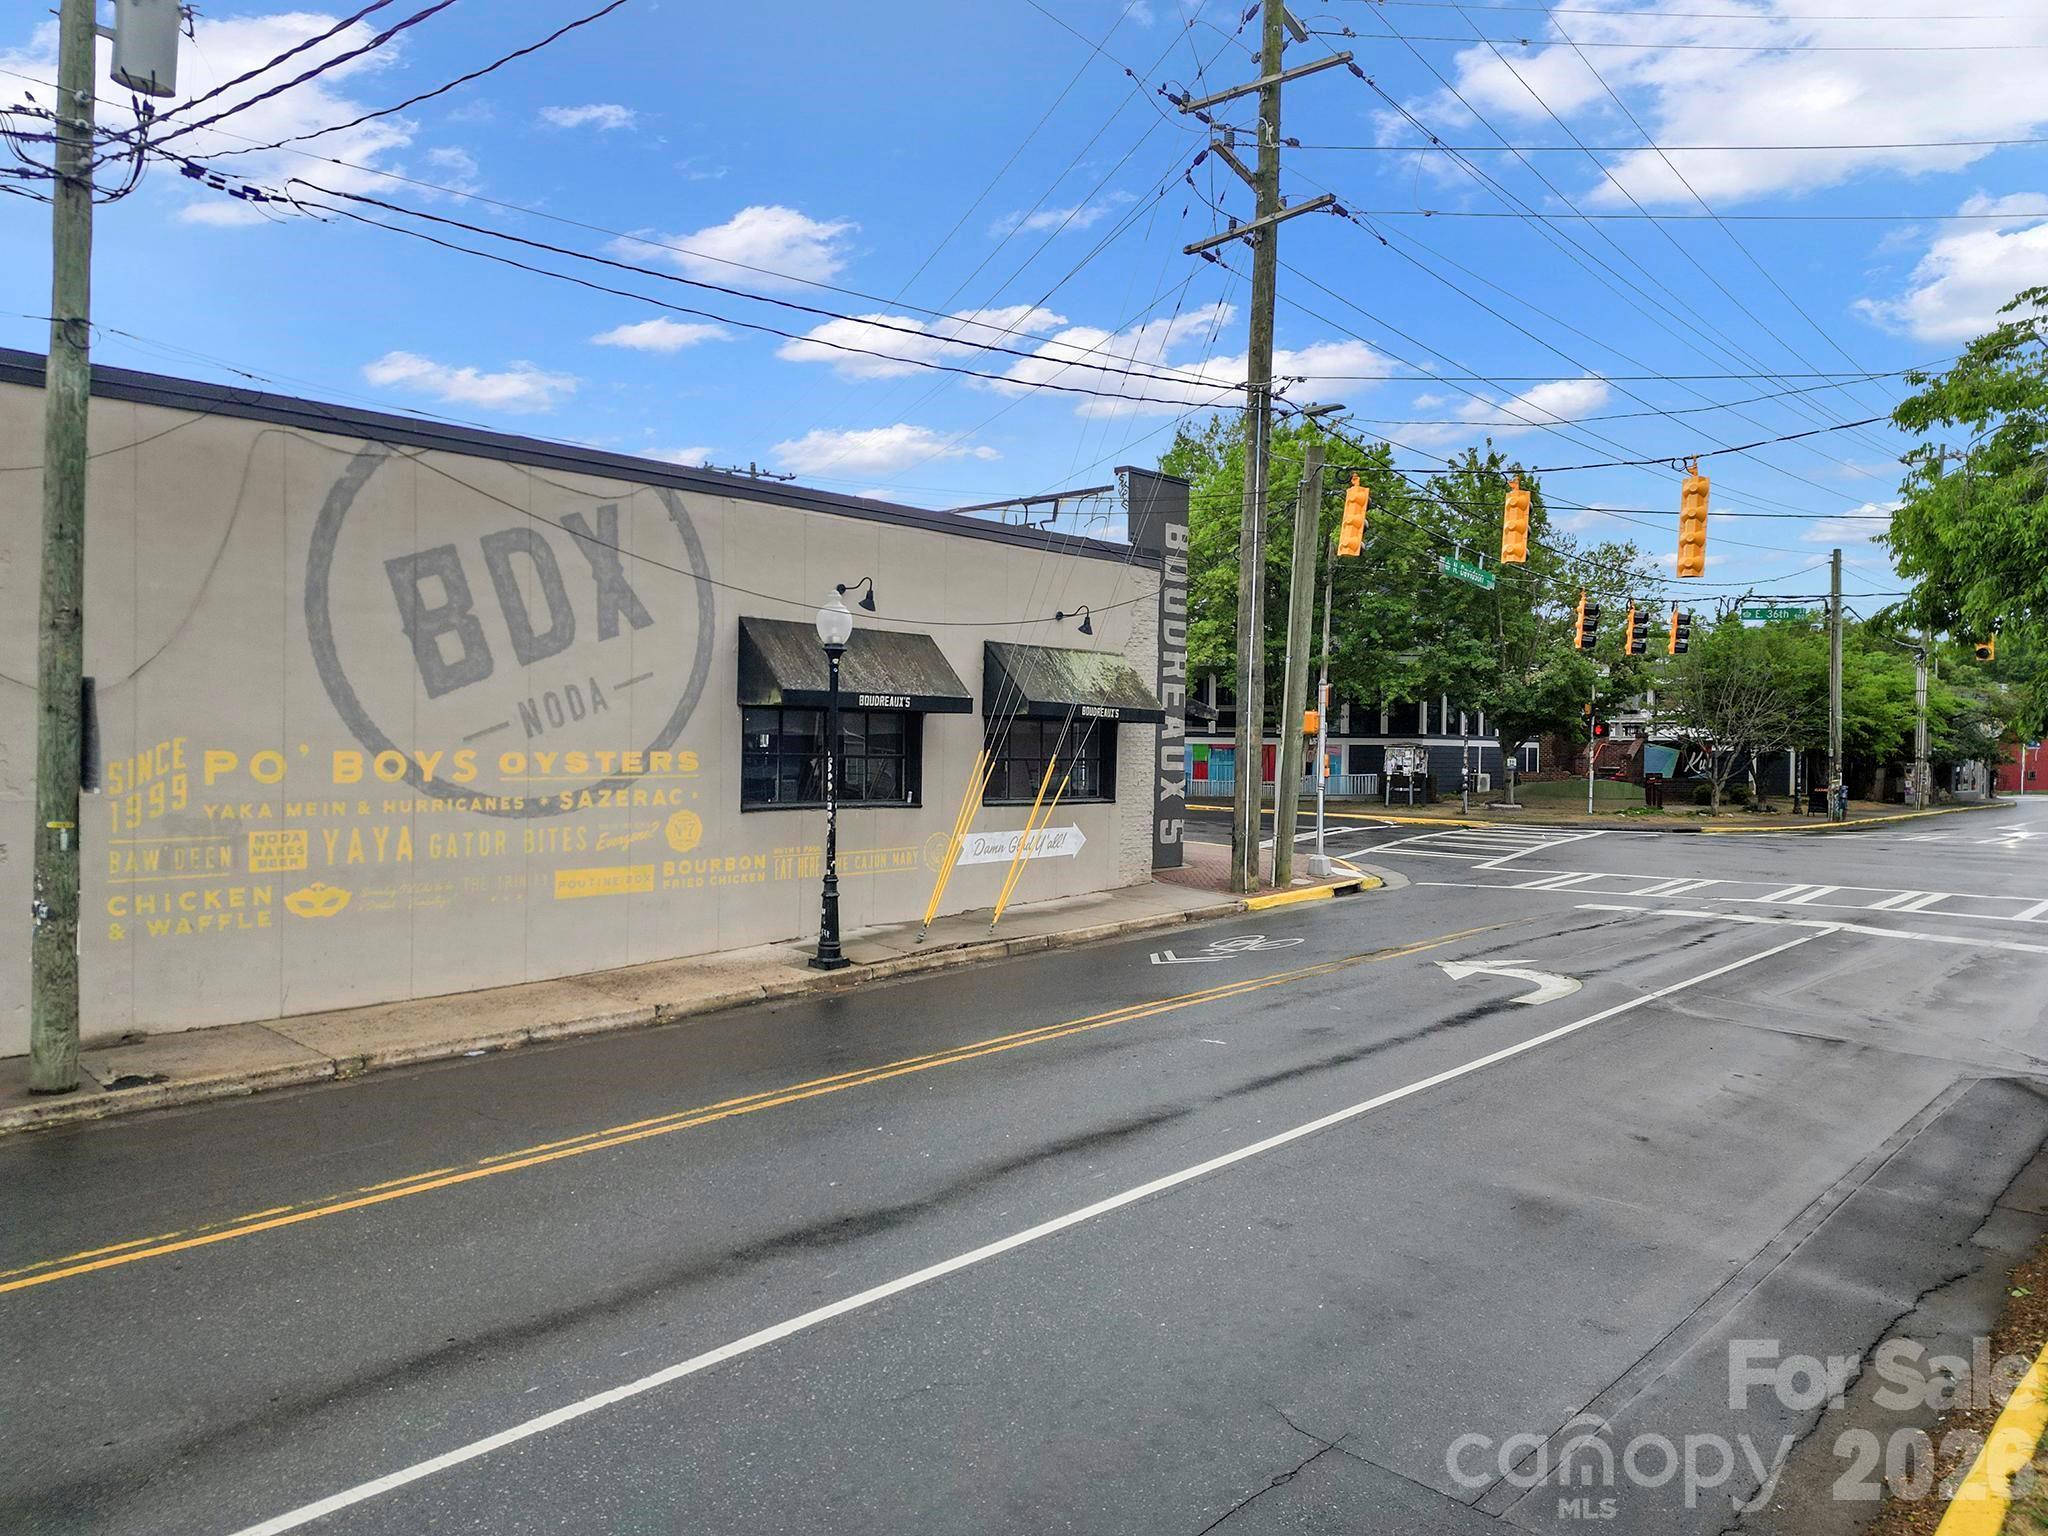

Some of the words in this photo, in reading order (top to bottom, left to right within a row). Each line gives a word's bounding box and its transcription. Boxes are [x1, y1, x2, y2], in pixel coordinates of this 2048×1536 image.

[384, 503, 655, 699] BDX
[1766, 609, 1790, 619] 36th
[518, 677, 609, 738] NODA
[858, 694, 911, 708] BOUDREAUX'S
[108, 736, 188, 796] SINCE
[204, 743, 309, 786] PO'
[332, 749, 479, 785] BOYS
[499, 751, 700, 774] OYSTERS
[111, 773, 188, 833] 1999
[203, 802, 273, 821] YAKA
[286, 800, 346, 818] MEIN
[357, 801, 371, 816] &
[383, 796, 525, 814] HURRICANES
[559, 788, 683, 811] SAZERAC
[252, 846, 306, 857] MAKES
[254, 833, 302, 845] NODA
[322, 825, 414, 866] YAYA
[429, 830, 507, 859] GATOR
[524, 825, 588, 855] BITES
[973, 838, 1007, 857] Damn
[663, 855, 767, 877] BOURBON
[855, 852, 887, 870] CAJUN
[663, 878, 705, 890] FRIED
[710, 871, 766, 887] CHICKEN
[107, 886, 273, 917] CHICKEN
[107, 922, 126, 942] &
[147, 910, 273, 938] WAFFLE
